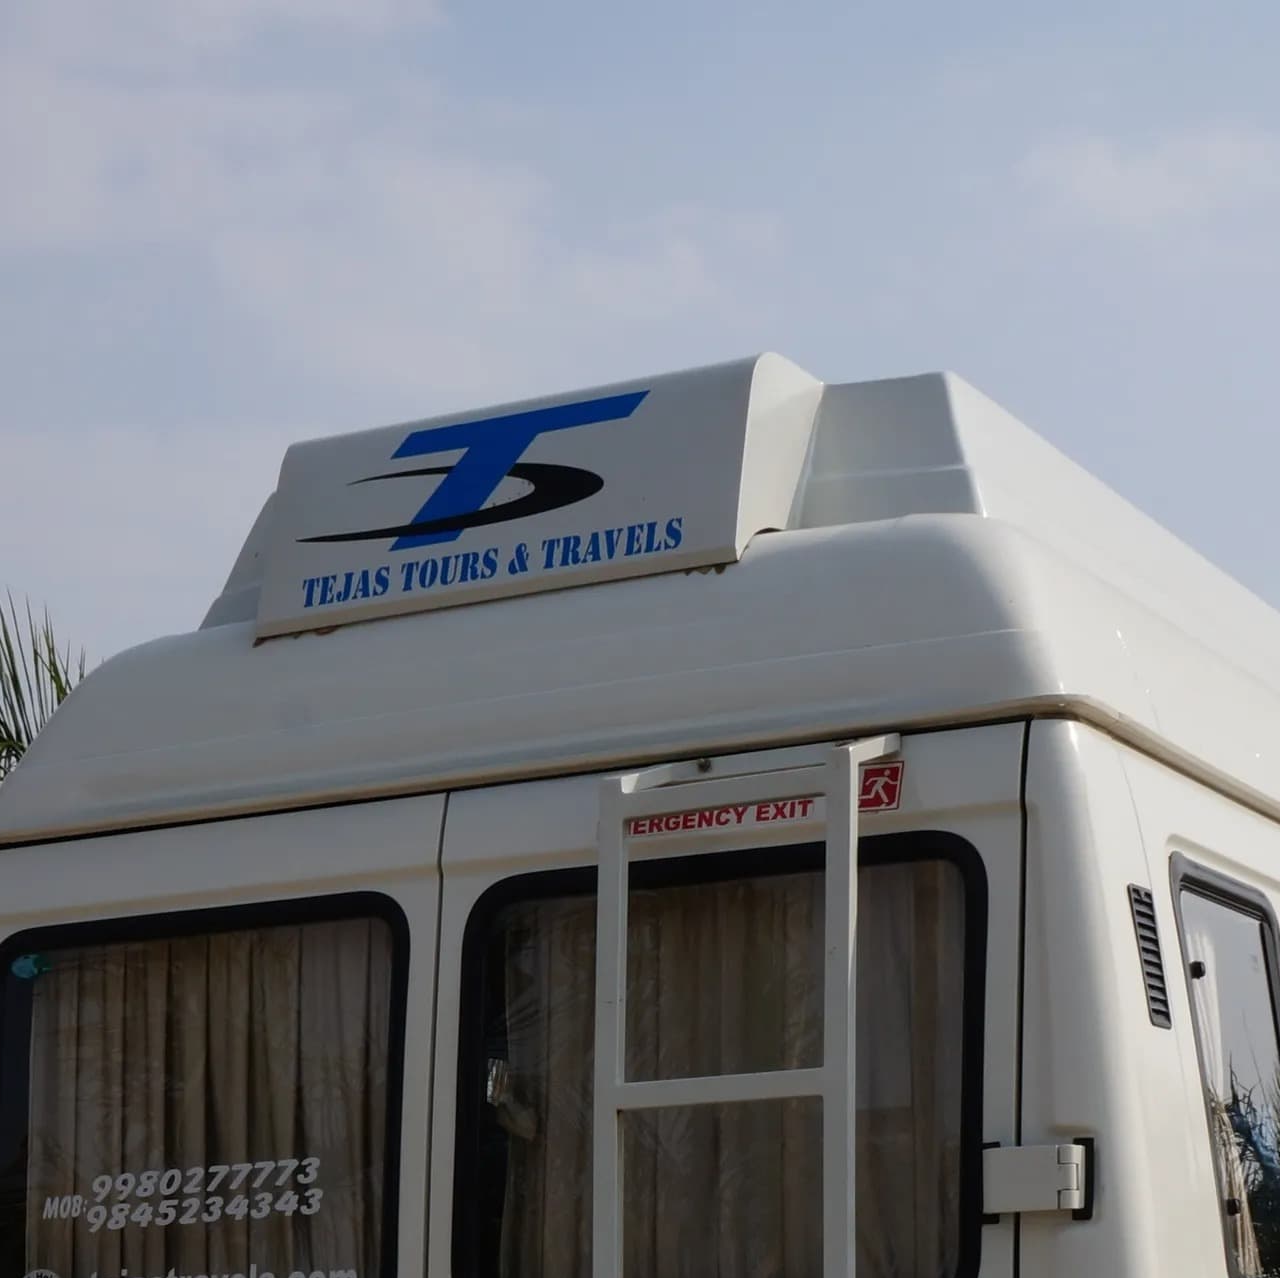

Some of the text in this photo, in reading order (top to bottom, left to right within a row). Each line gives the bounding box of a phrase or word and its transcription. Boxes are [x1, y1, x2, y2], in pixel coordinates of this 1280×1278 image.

[302, 516, 684, 608] TEJAS TOURS & TRAVELS
[628, 799, 814, 836] ERGENCY EXIT
[91, 1156, 321, 1205] 9980277773
[86, 1188, 324, 1233] 9845234343
